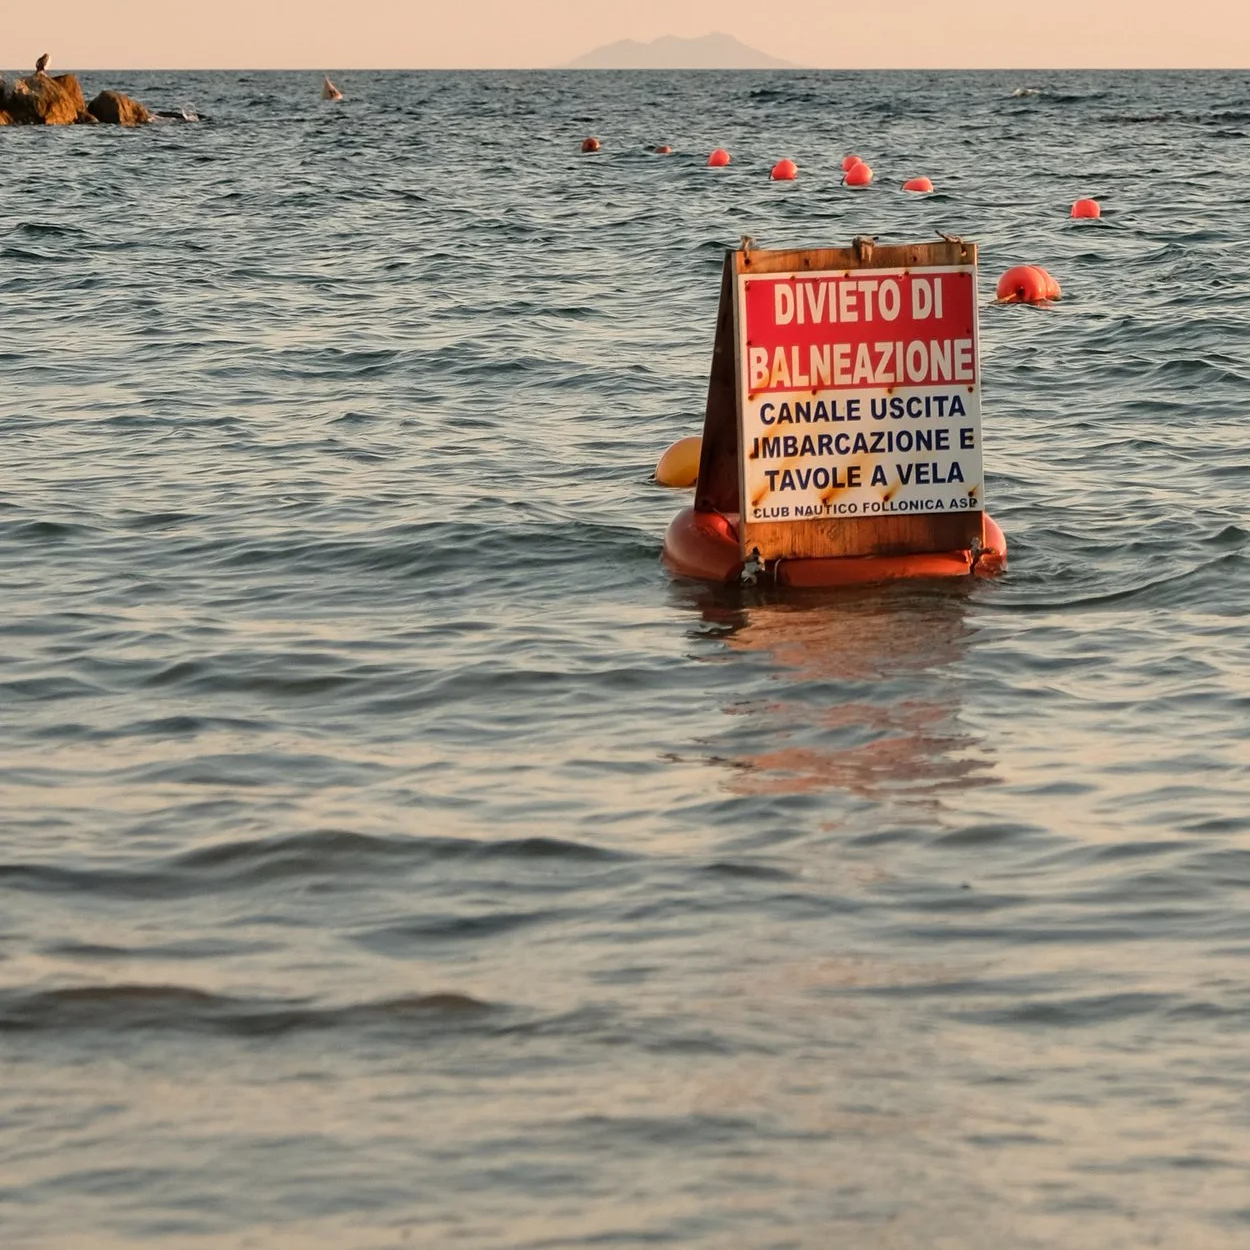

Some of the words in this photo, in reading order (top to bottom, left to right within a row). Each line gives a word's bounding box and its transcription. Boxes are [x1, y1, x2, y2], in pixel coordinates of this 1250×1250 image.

[774, 279, 901, 325] DIVIETO
[911, 277, 943, 320] DI
[749, 338, 973, 389] BALNEAZIONE
[759, 398, 861, 425] CANALE
[870, 395, 966, 420] USCITA
[752, 429, 950, 459] IMBARCAZIONE
[960, 428, 975, 449] E
[764, 465, 861, 492] TAVOLE
[870, 464, 888, 487] A
[896, 461, 965, 485] VELA
[753, 505, 790, 519] CLUB
[795, 503, 858, 517] NAUTICO
[863, 498, 944, 513] FOLLONICA
